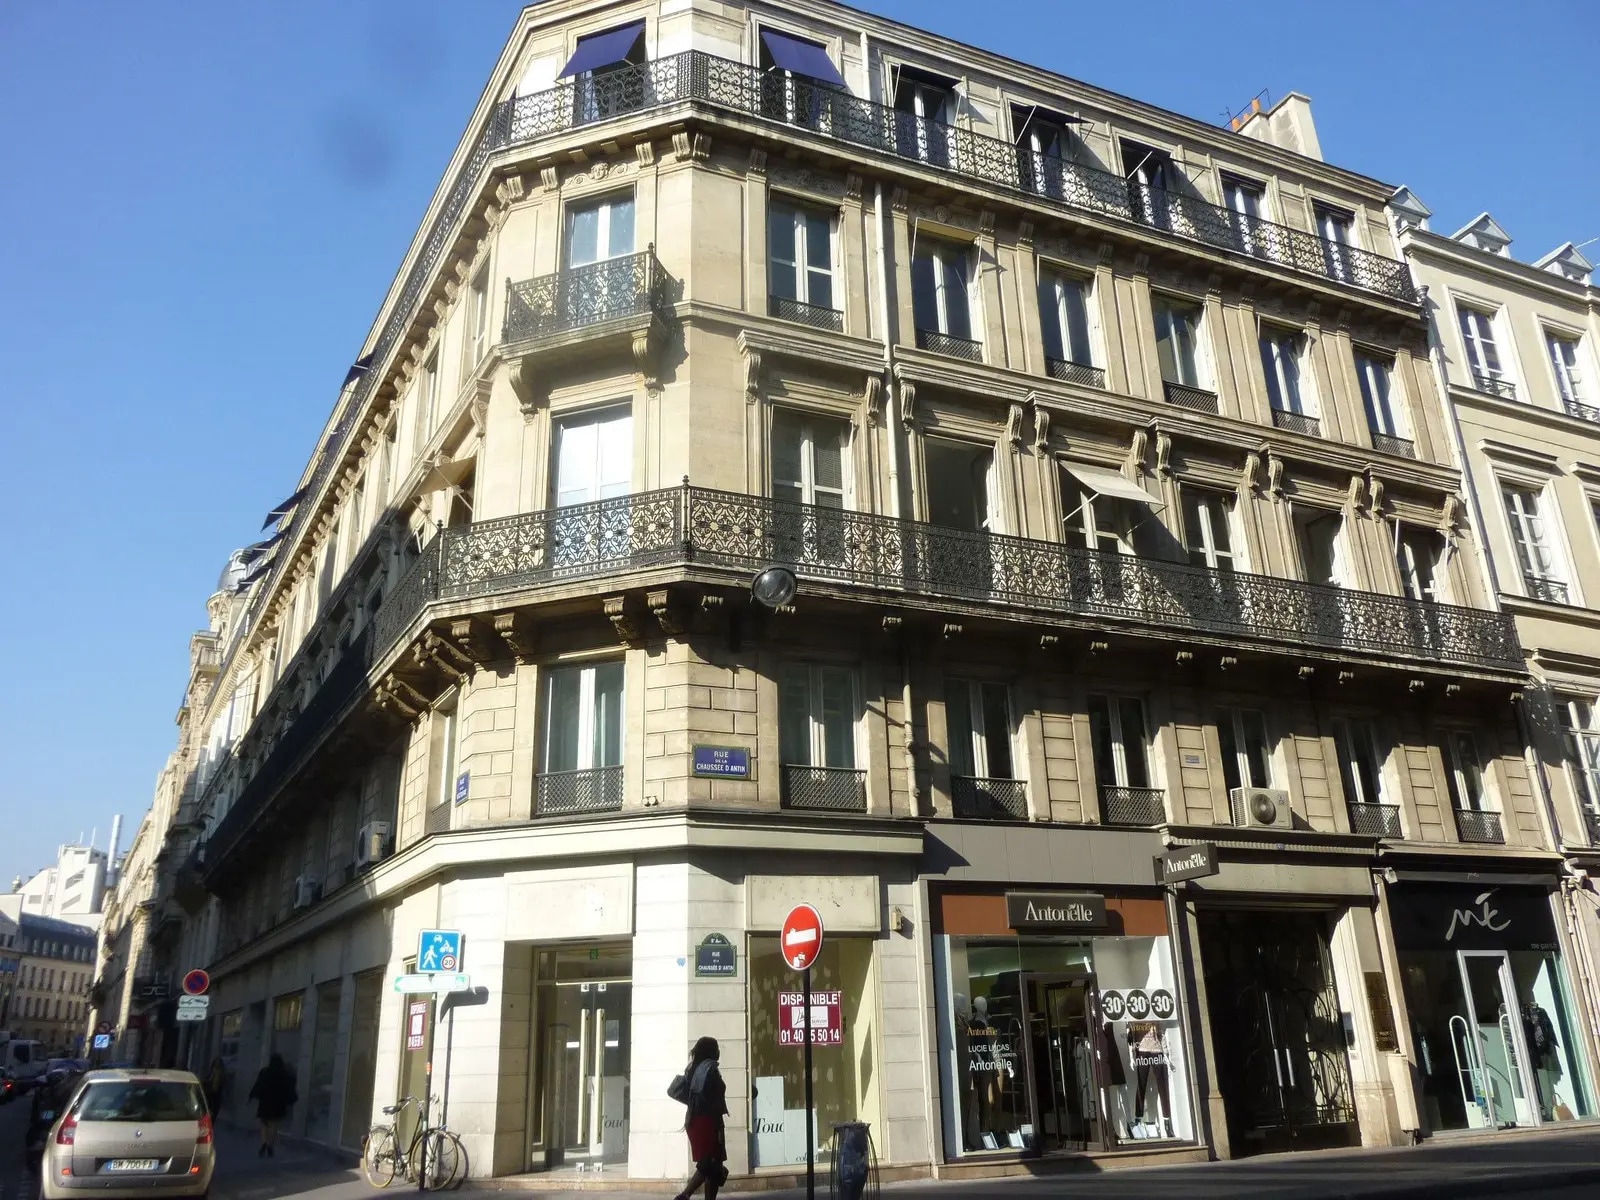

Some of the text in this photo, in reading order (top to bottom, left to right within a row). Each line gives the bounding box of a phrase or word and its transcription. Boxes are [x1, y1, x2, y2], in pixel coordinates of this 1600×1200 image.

[713, 750, 729, 758] RUE
[782, 1030, 790, 1042] 01
[794, 1030, 804, 1042] 40
[818, 1029, 828, 1042] 50
[830, 1028, 840, 1041] 14
[968, 1044, 988, 1052] LUCIE
[969, 1058, 1012, 1071] Antonelle
